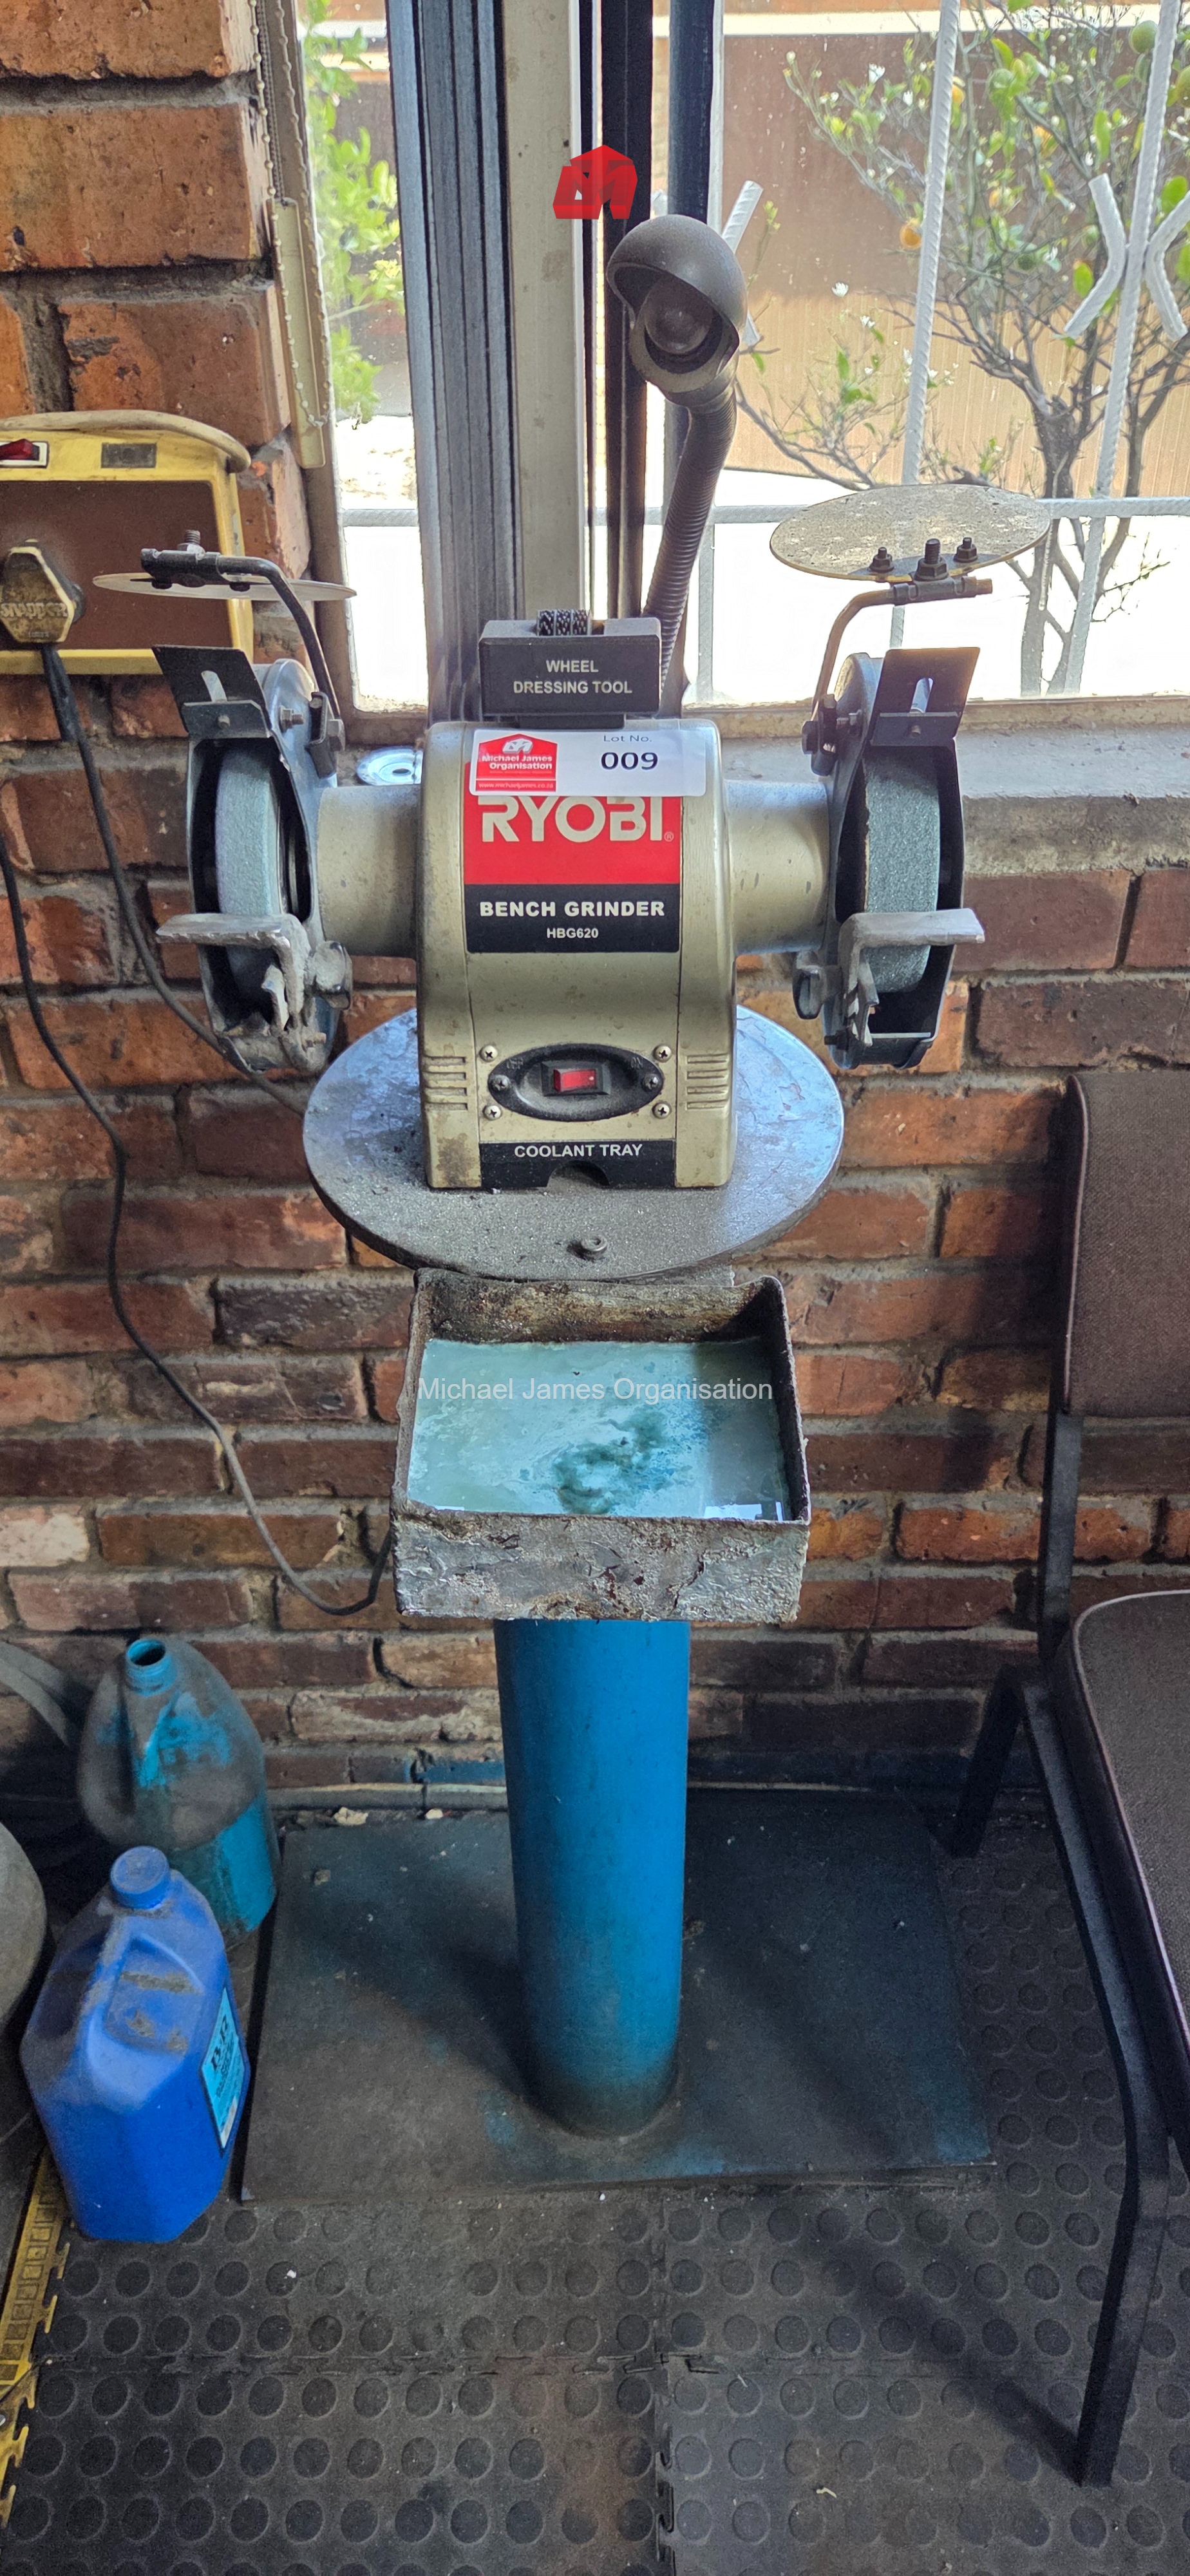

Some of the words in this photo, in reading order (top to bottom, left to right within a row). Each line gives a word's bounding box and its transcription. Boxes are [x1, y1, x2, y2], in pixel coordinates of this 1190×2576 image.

[546, 660, 599, 672] WHEEL
[514, 681, 588, 694] DRESSING
[592, 681, 632, 694] TOOL
[601, 752, 658, 770] 009
[478, 796, 662, 842] RYOBI
[480, 902, 556, 916] BENCH
[564, 902, 665, 916] GRINDER
[547, 927, 599, 938] HBG620
[515, 1144, 595, 1157] COOLANT
[600, 1144, 643, 1157] TRAY
